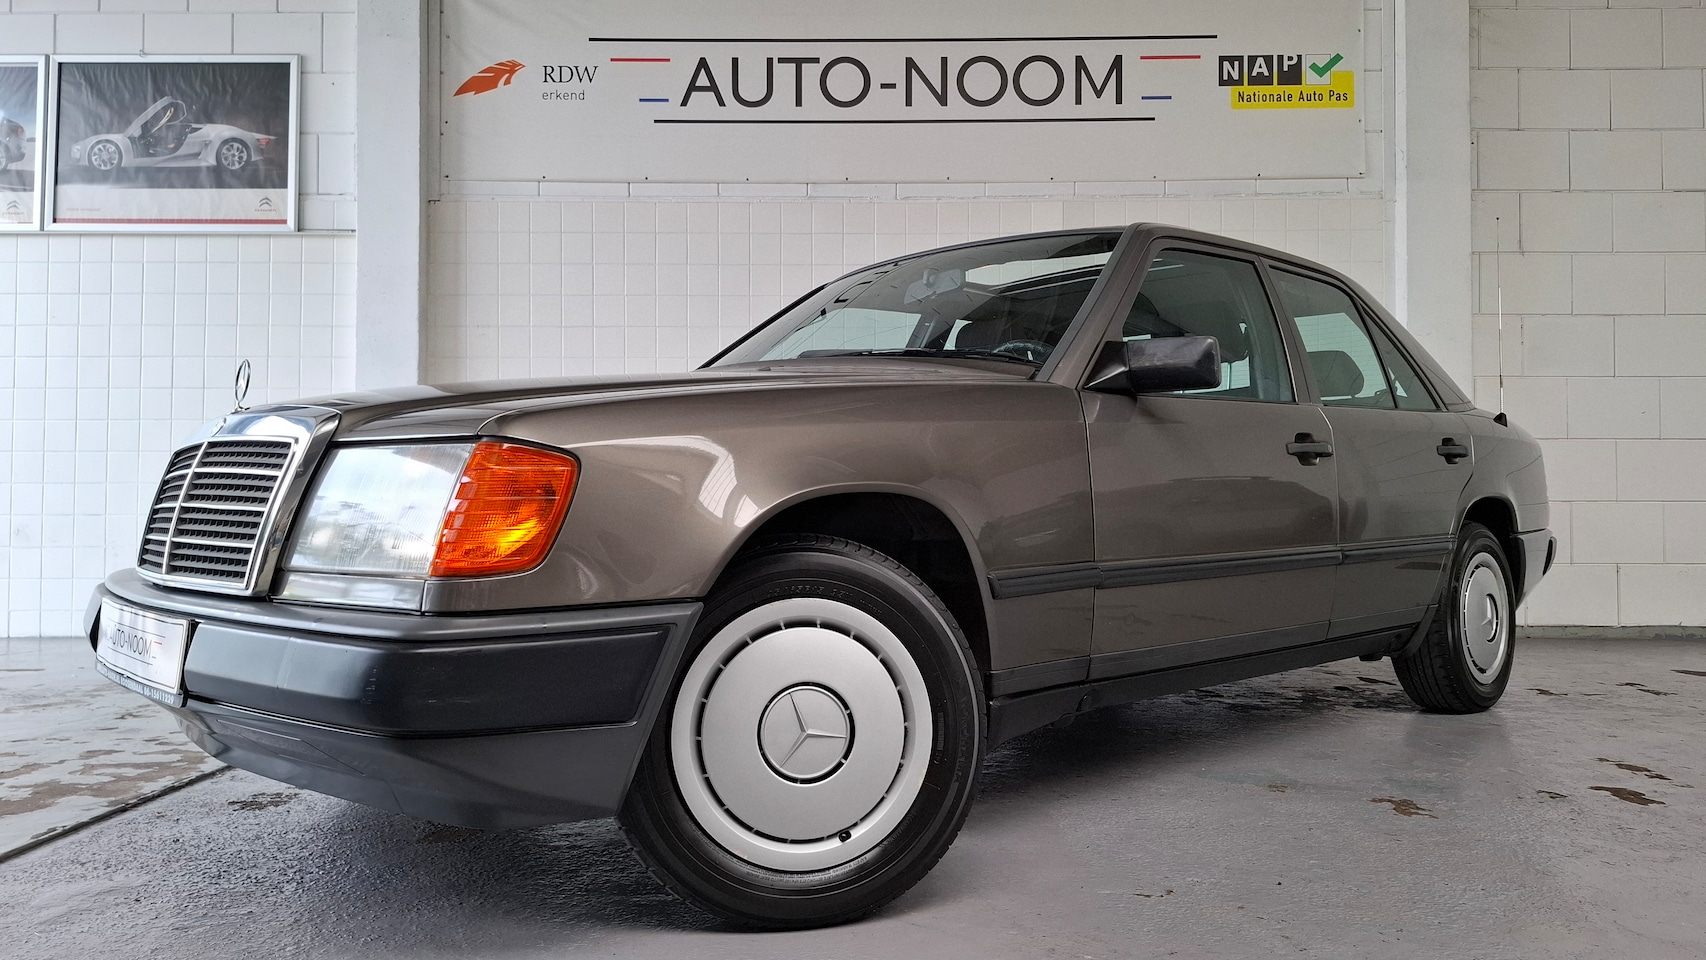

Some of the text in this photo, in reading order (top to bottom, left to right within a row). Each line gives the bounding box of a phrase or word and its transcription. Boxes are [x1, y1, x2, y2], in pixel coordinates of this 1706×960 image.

[542, 65, 599, 83] RDW
[1222, 54, 1299, 81] NAP
[680, 55, 1123, 108] AUTO-NOOM
[542, 89, 585, 101] erkend
[1238, 89, 1348, 103] Nationale Auto Pas
